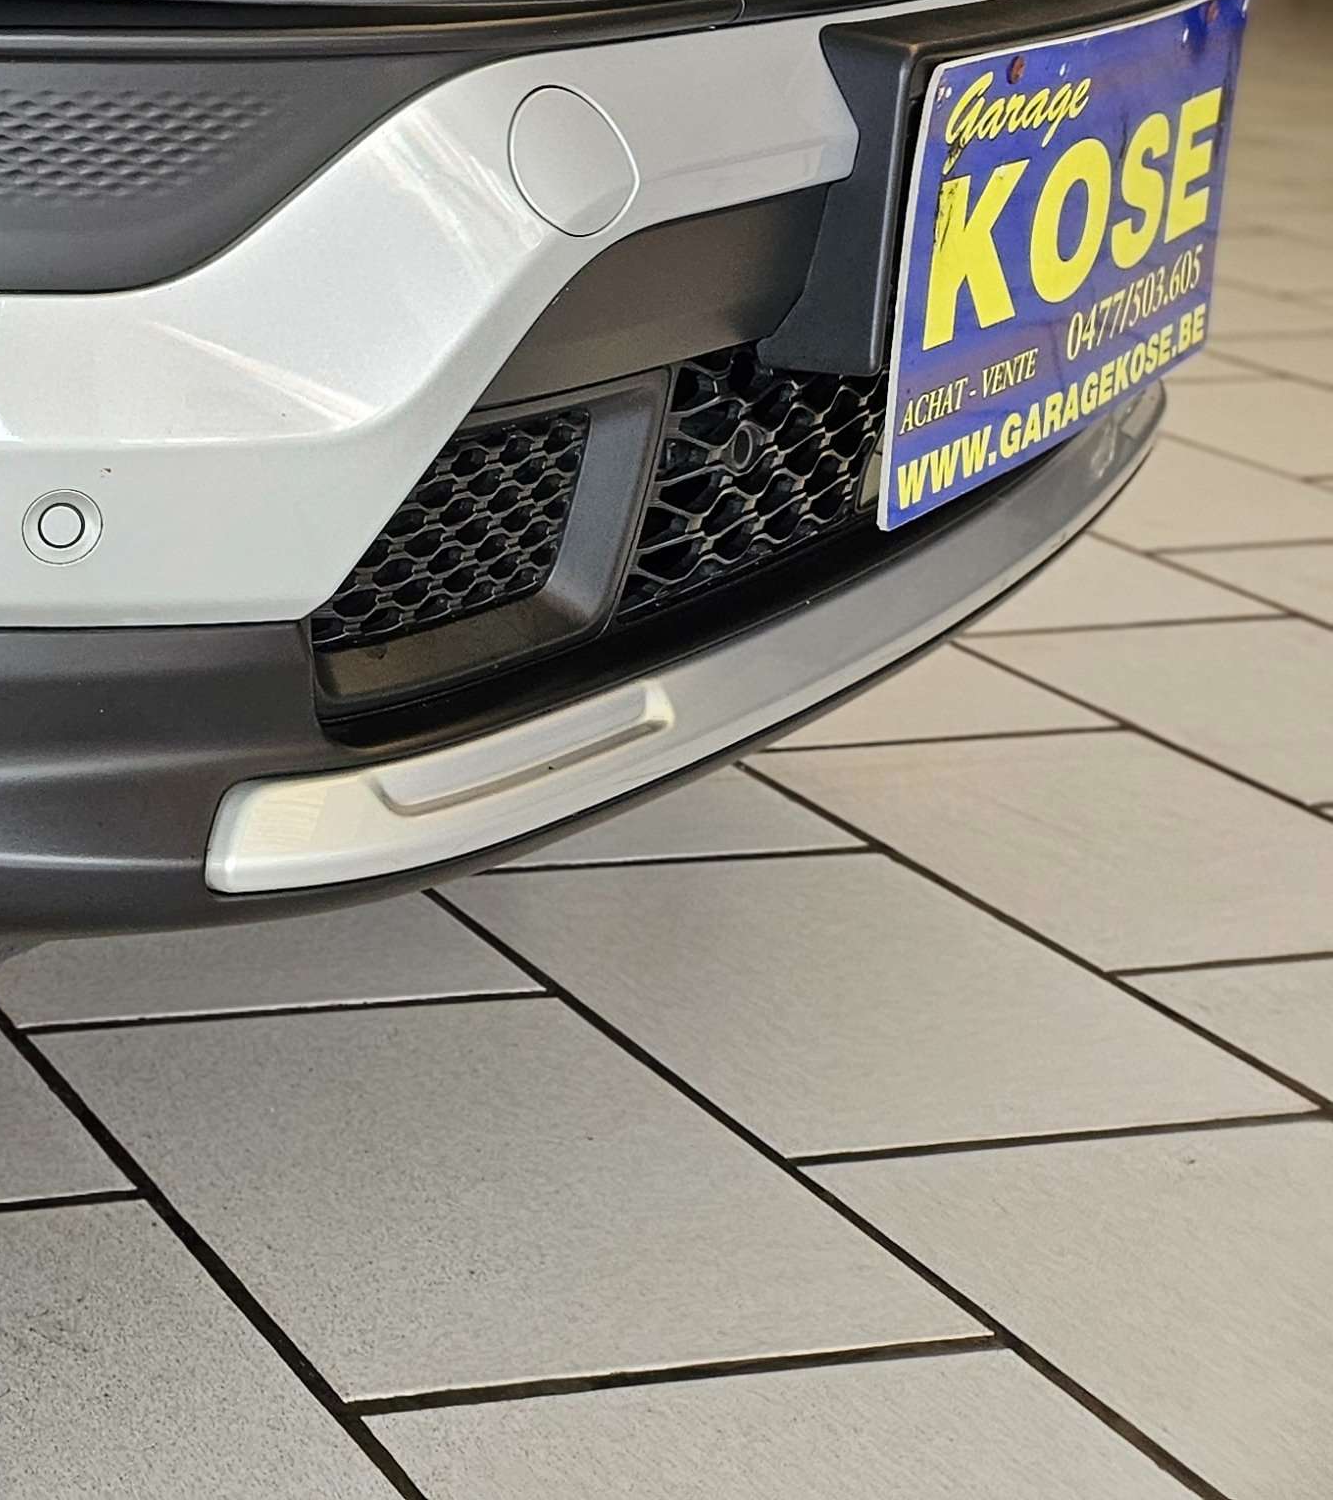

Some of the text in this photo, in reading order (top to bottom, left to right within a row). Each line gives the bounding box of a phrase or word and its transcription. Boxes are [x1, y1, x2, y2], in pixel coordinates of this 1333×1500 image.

[942, 70, 1090, 174] Garage
[921, 87, 1223, 352] KOSE
[1066, 243, 1204, 362] 0477/503.605
[896, 303, 1207, 511] WWW.GARAGEKOSE.BE
[899, 374, 970, 435] ACHAT
[981, 347, 1039, 394] VENTE
